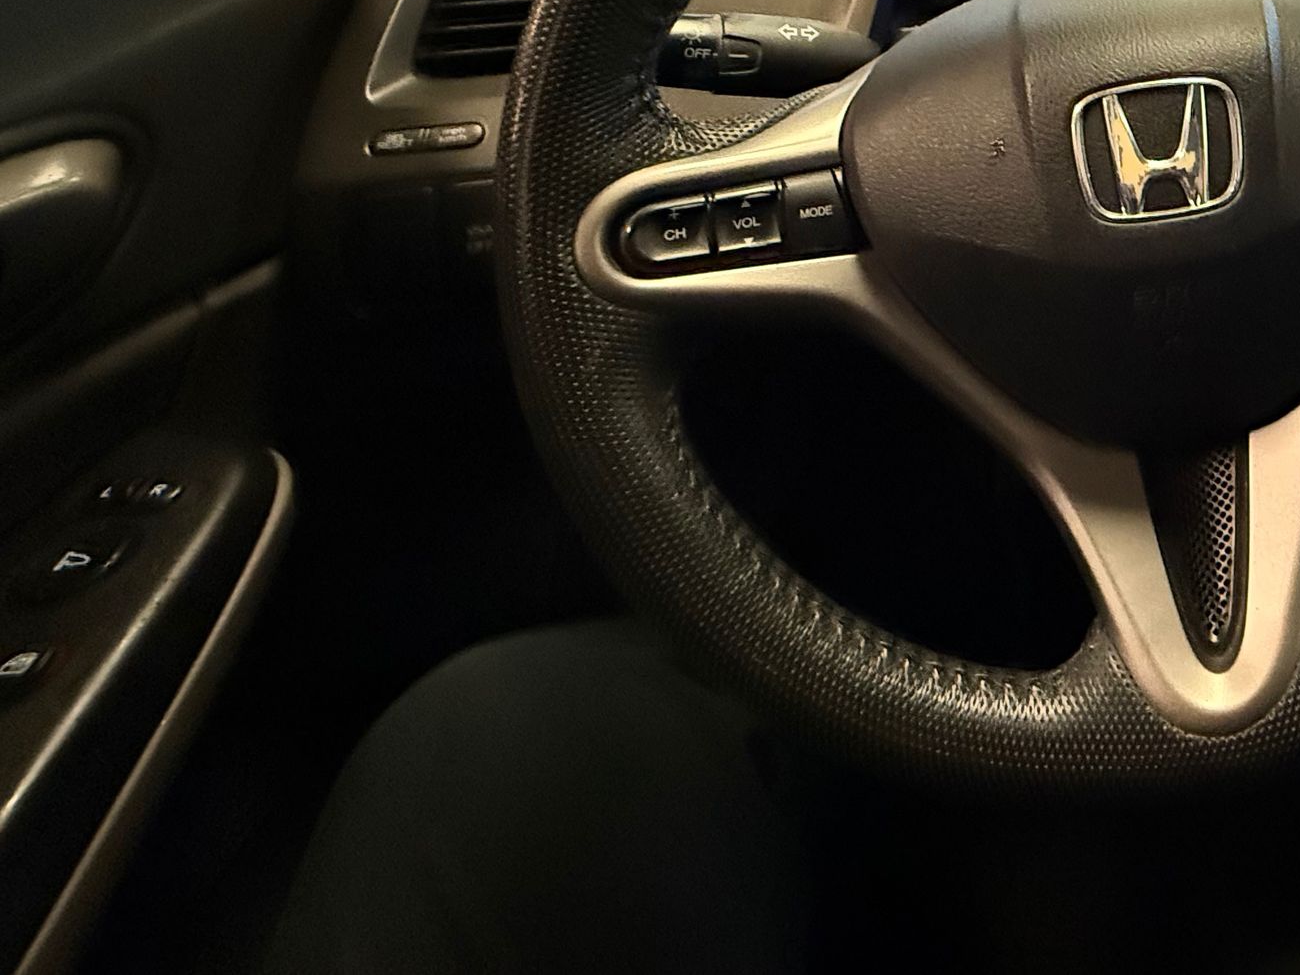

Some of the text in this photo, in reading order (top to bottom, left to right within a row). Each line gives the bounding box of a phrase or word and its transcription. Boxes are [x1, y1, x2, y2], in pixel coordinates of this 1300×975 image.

[684, 47, 712, 59] OFF
[799, 205, 834, 219] MODE
[733, 216, 761, 230] VOL
[663, 228, 687, 242] CH
